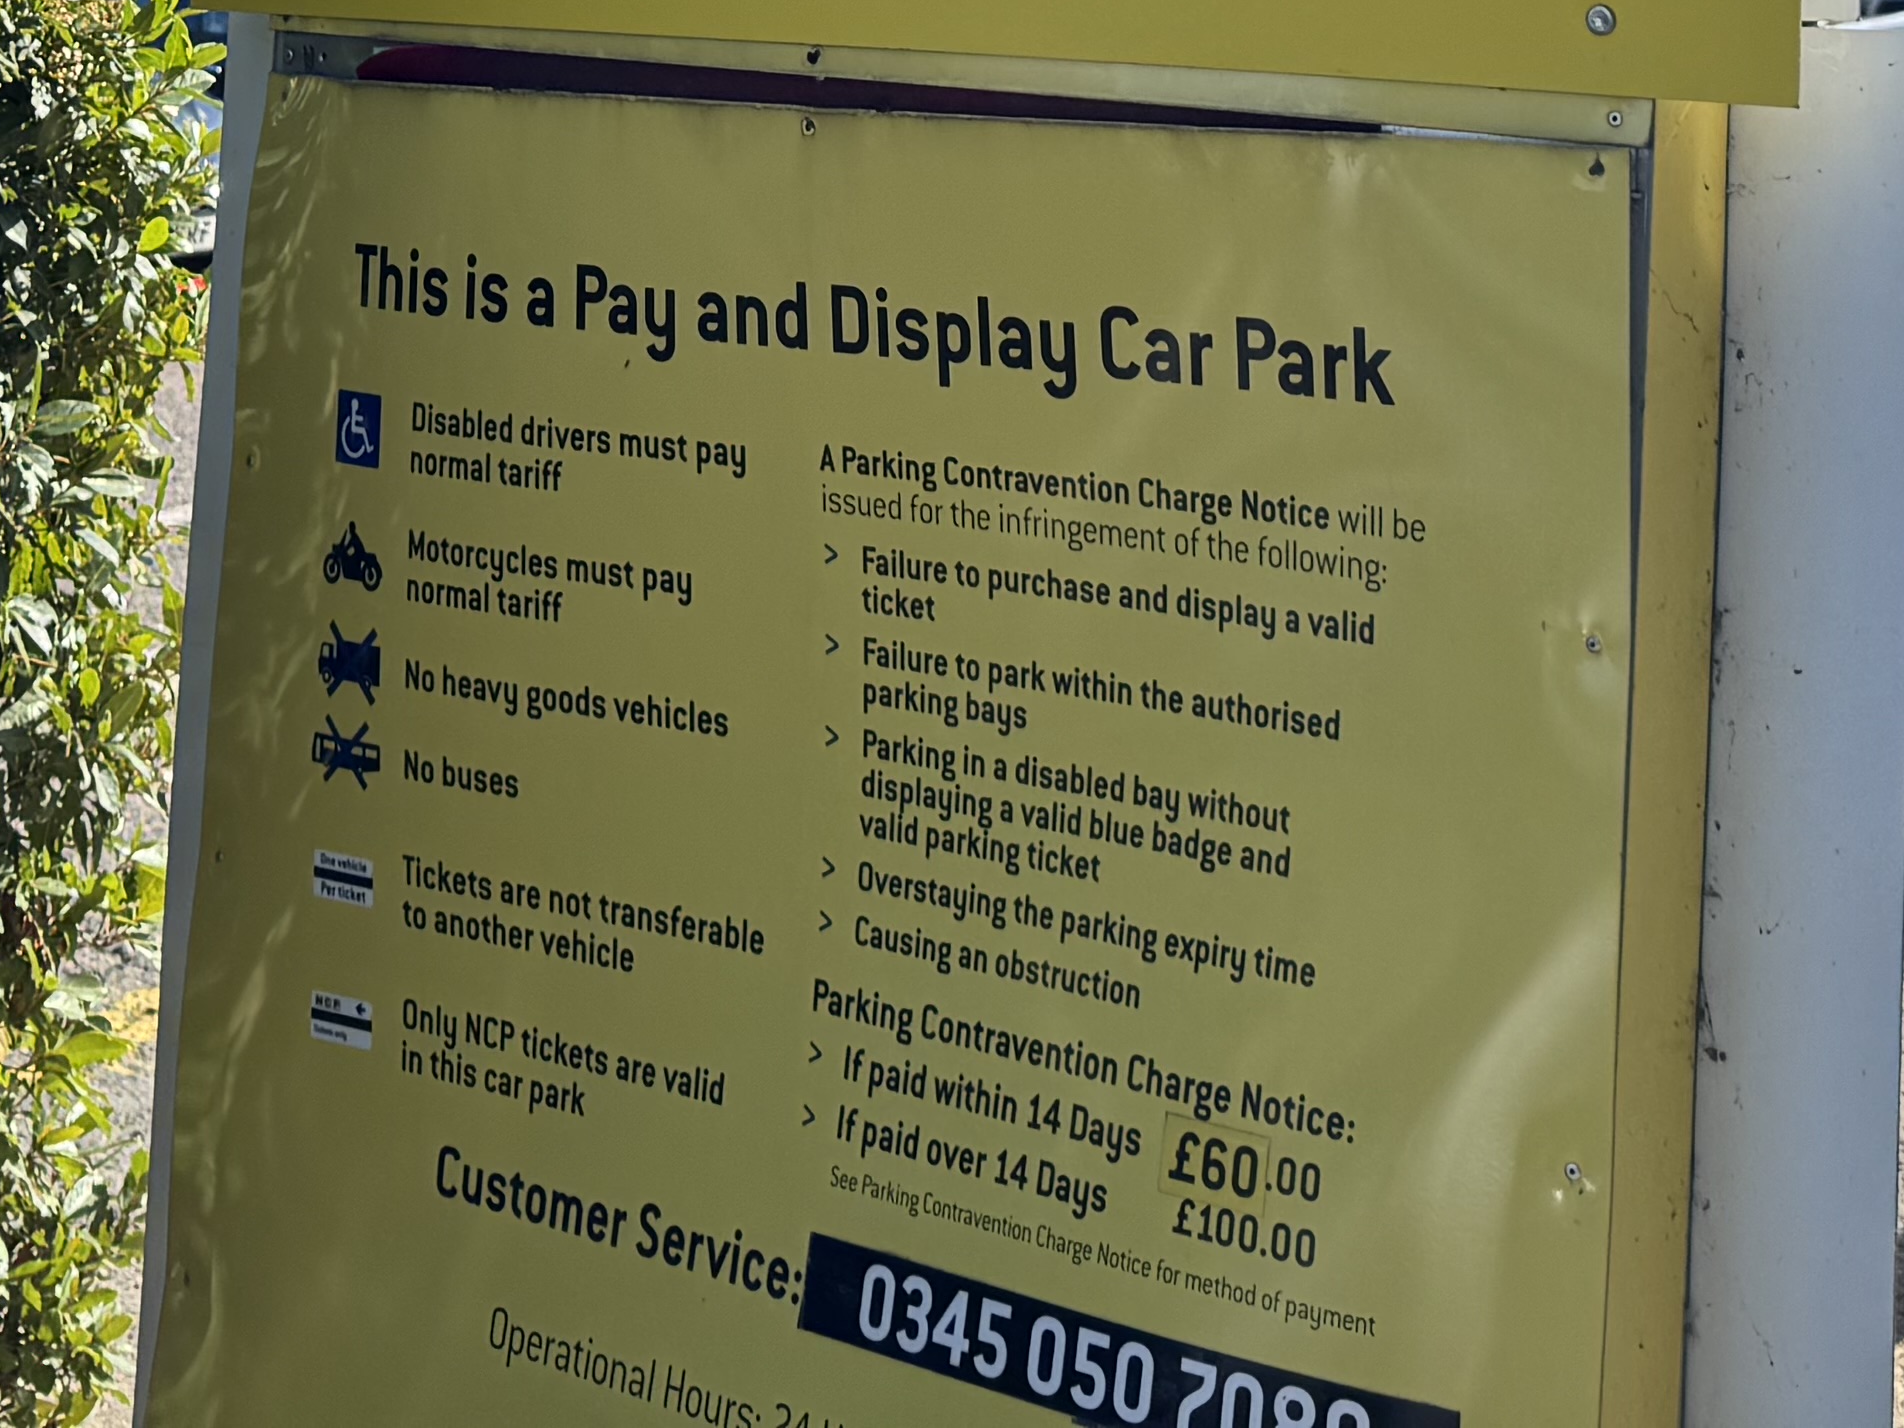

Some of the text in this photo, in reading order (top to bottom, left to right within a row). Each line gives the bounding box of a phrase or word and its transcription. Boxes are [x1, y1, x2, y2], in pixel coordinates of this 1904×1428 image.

[355, 243, 1395, 406] This is a Pay and Display Car Park
[410, 451, 563, 492] normal tariff
[412, 401, 746, 479] Disabled drivers must pay
[819, 443, 1426, 543] A Parking Contravention Charge Notice will be
[822, 483, 1387, 593] issued for the infringement of the following:
[407, 579, 563, 623] normal tariff
[408, 528, 692, 607] Motorcycles must pay
[861, 585, 935, 622] ticket
[862, 545, 1374, 645] Failure to purchase and display a valid
[405, 658, 728, 737] No heavy goods vehicles
[863, 636, 1340, 741] Failure to park within the authorised
[863, 681, 1027, 737] parking bays
[404, 749, 519, 798] No buses
[861, 769, 1291, 878] displaying a valid blue badge and
[863, 728, 1290, 835] Parking in a disabled bay without
[321, 880, 366, 904] Per ticket
[859, 811, 1101, 883] valid parking ticket
[402, 854, 764, 955] Tickets are not transferable
[402, 900, 634, 973] to another vehicle
[858, 861, 1315, 987] Overstaying the parking expiry time
[855, 915, 1140, 1009] Causing an obstruction
[402, 1040, 585, 1117] in this car park
[403, 998, 725, 1106] Only NCP tickets are valid
[813, 978, 1355, 1144] Parking Contravention Charge Notice:
[843, 1045, 1321, 1202] If paid within 14 Days £60.00
[836, 1104, 1316, 1268] If paid over 14 Days £100.00
[436, 1145, 627, 1248] Customer
[636, 1202, 802, 1305] Service:
[858, 1263, 1013, 1380] 0345
[1026, 1315, 1155, 1424] 050
[830, 1165, 1376, 1337] See Parking Contravention Charge Notice for method of payment
[489, 1307, 656, 1403] Operational
